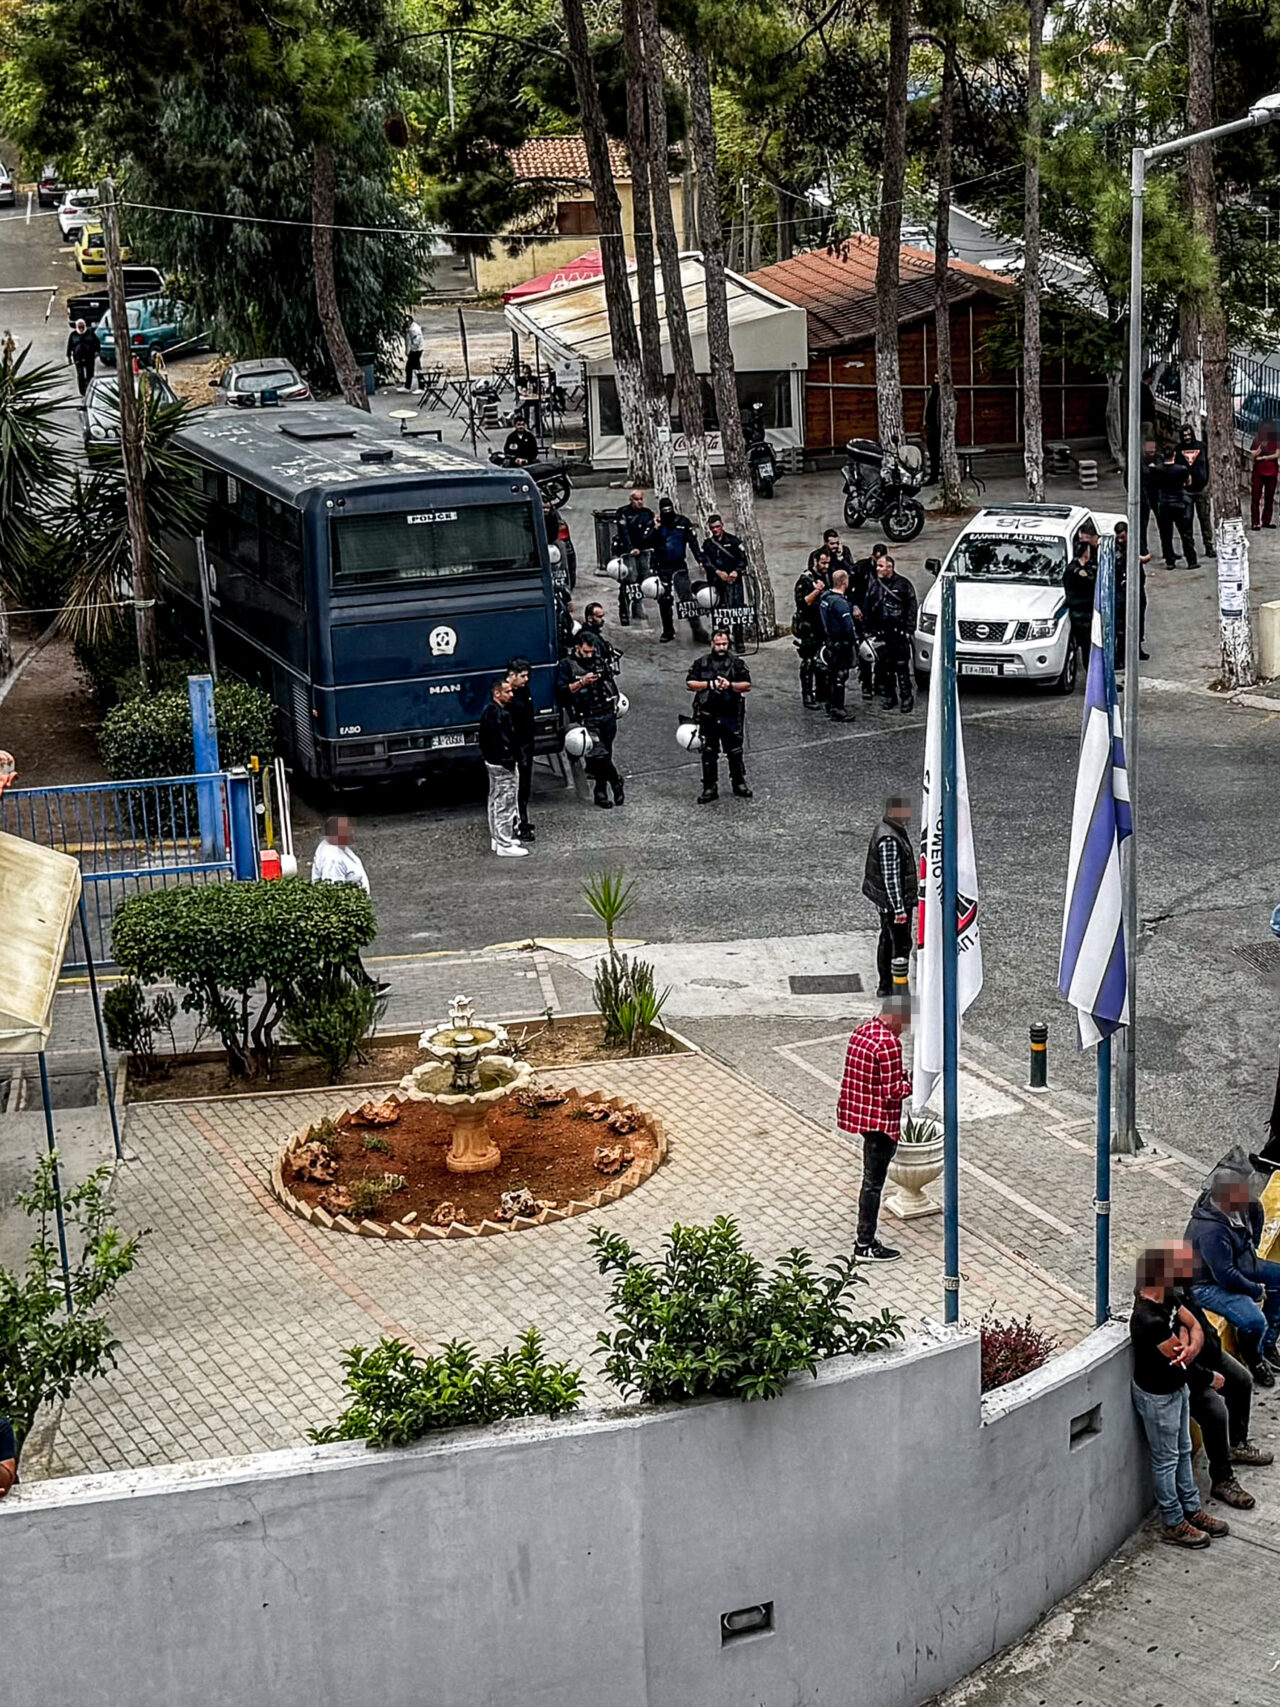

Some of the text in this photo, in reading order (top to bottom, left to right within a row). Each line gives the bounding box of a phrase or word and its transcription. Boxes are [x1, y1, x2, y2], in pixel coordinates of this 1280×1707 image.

[411, 512, 452, 522] POLICE
[715, 616, 754, 625] POLICE
[429, 683, 461, 695] MAN
